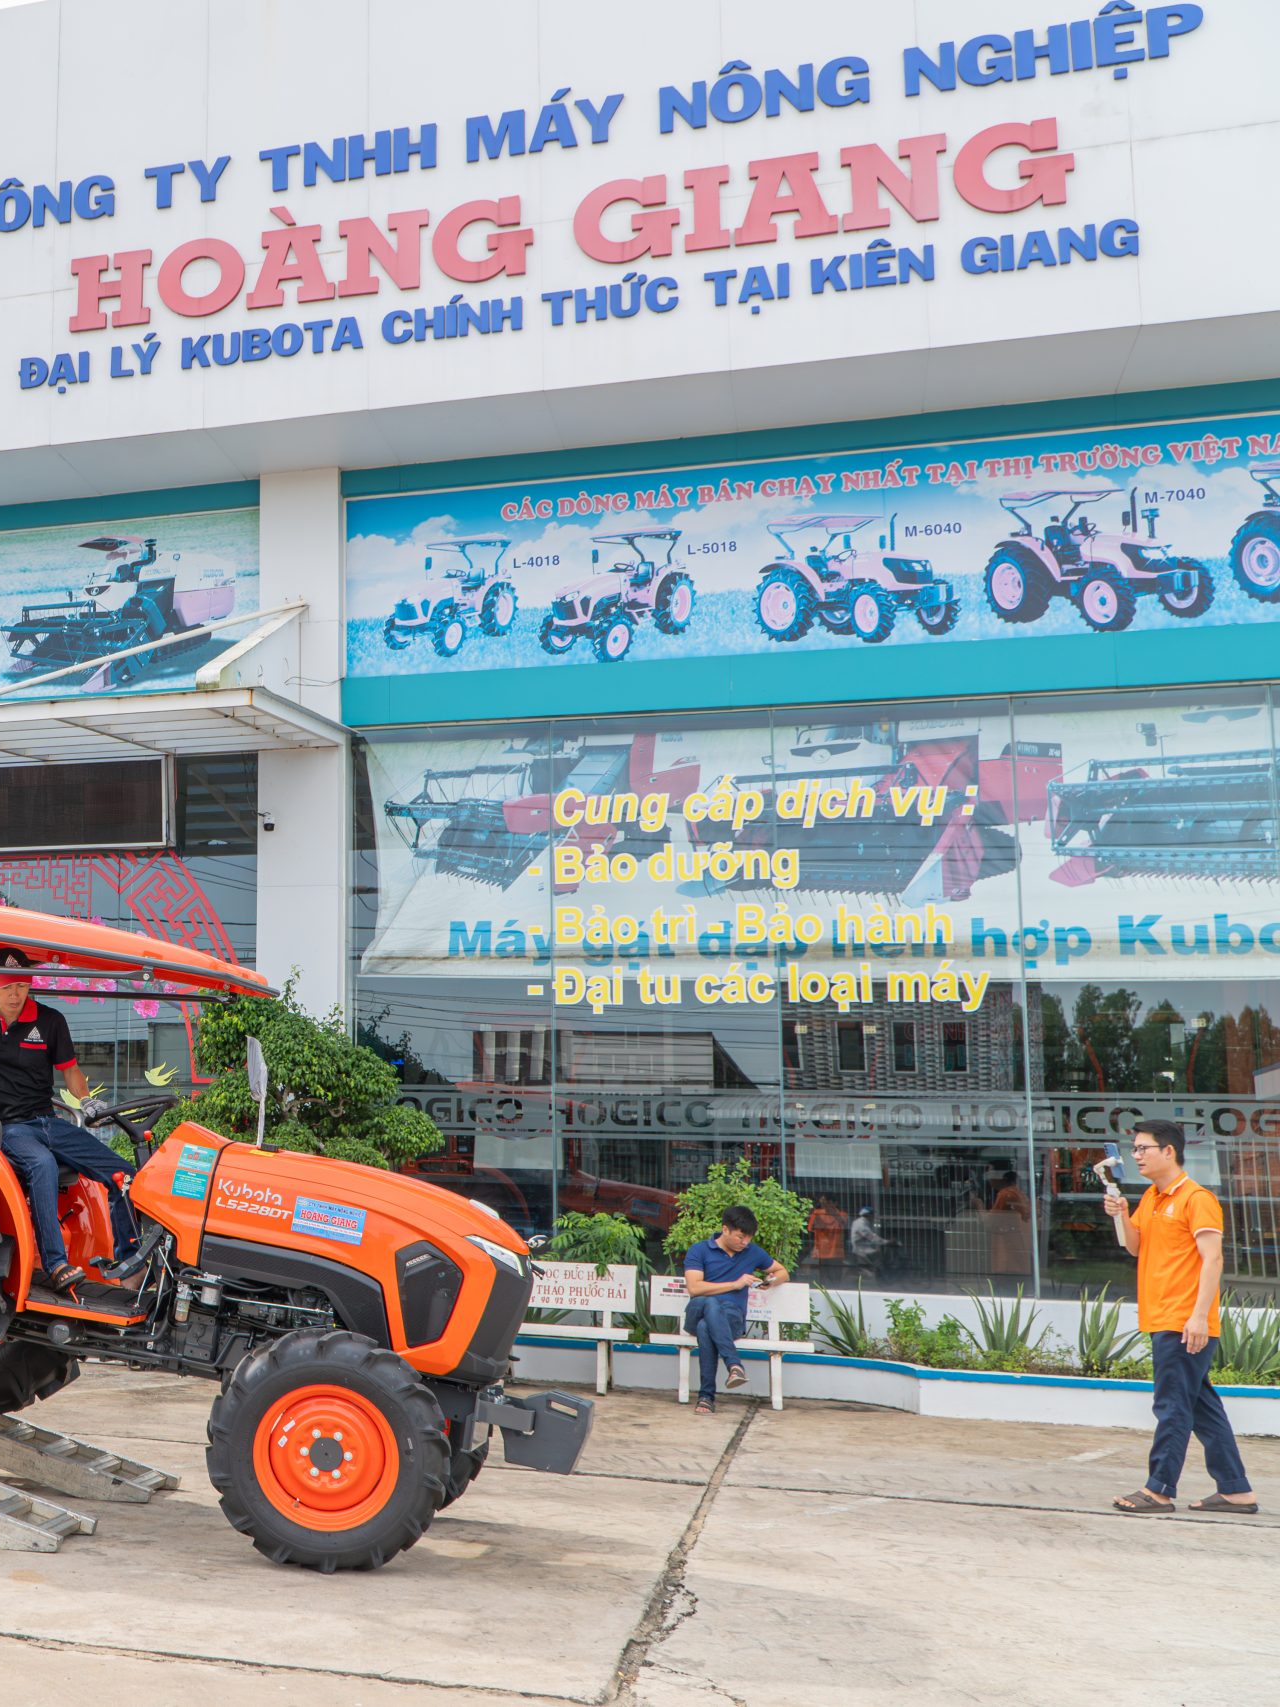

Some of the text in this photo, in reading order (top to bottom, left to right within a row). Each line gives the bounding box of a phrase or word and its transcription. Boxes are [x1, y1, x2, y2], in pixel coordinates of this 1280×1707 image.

[145, 155, 231, 209] TY
[259, 123, 437, 192] TNHH
[466, 87, 624, 163] MÁY
[660, 59, 870, 134] NÔNG
[903, 0, 1204, 98] NGHIỆP
[69, 117, 1074, 333] HOÀNG GIANG
[19, 218, 1140, 393] ĐẠI LÝ KUBOTA CHÍNH THỨC TẠI KIÊN GIANG
[501, 497, 554, 522] CÁC
[557, 491, 630, 518] DÒNG
[635, 483, 692, 511] MÁY
[698, 478, 755, 505] BÁN
[759, 473, 834, 499] CHẠY
[841, 458, 921, 492] NHẤT
[926, 460, 977, 487] TẠI
[983, 456, 1034, 481] THỊ
[1039, 444, 1162, 475] TRƯỜNG
[1167, 433, 1241, 465] VIỆT
[1145, 488, 1206, 503] M-7040
[687, 540, 738, 556] L-5018
[904, 522, 962, 538] M-6040
[513, 554, 560, 569] L-4018
[553, 788, 669, 832] Cung
[682, 774, 764, 830] cấp
[775, 778, 876, 828] dịch
[889, 784, 948, 826] vụ
[553, 842, 638, 885] Bảo
[648, 841, 800, 889] dưỡng
[555, 904, 639, 944] Bảo
[651, 904, 697, 944] trì
[735, 902, 823, 944] Bảo
[837, 903, 953, 944] hành
[971, 918, 1092, 969] hợp
[553, 966, 624, 1014] Đại
[638, 965, 681, 1005] tu
[695, 962, 775, 1004] các
[789, 962, 872, 1012] loại
[887, 960, 991, 1012] máy
[395, 1096, 523, 1124] OGICO
[548, 1100, 715, 1128] HOGICO
[218, 1178, 282, 1206] Kubota
[331, 1216, 358, 1229] GIANG
